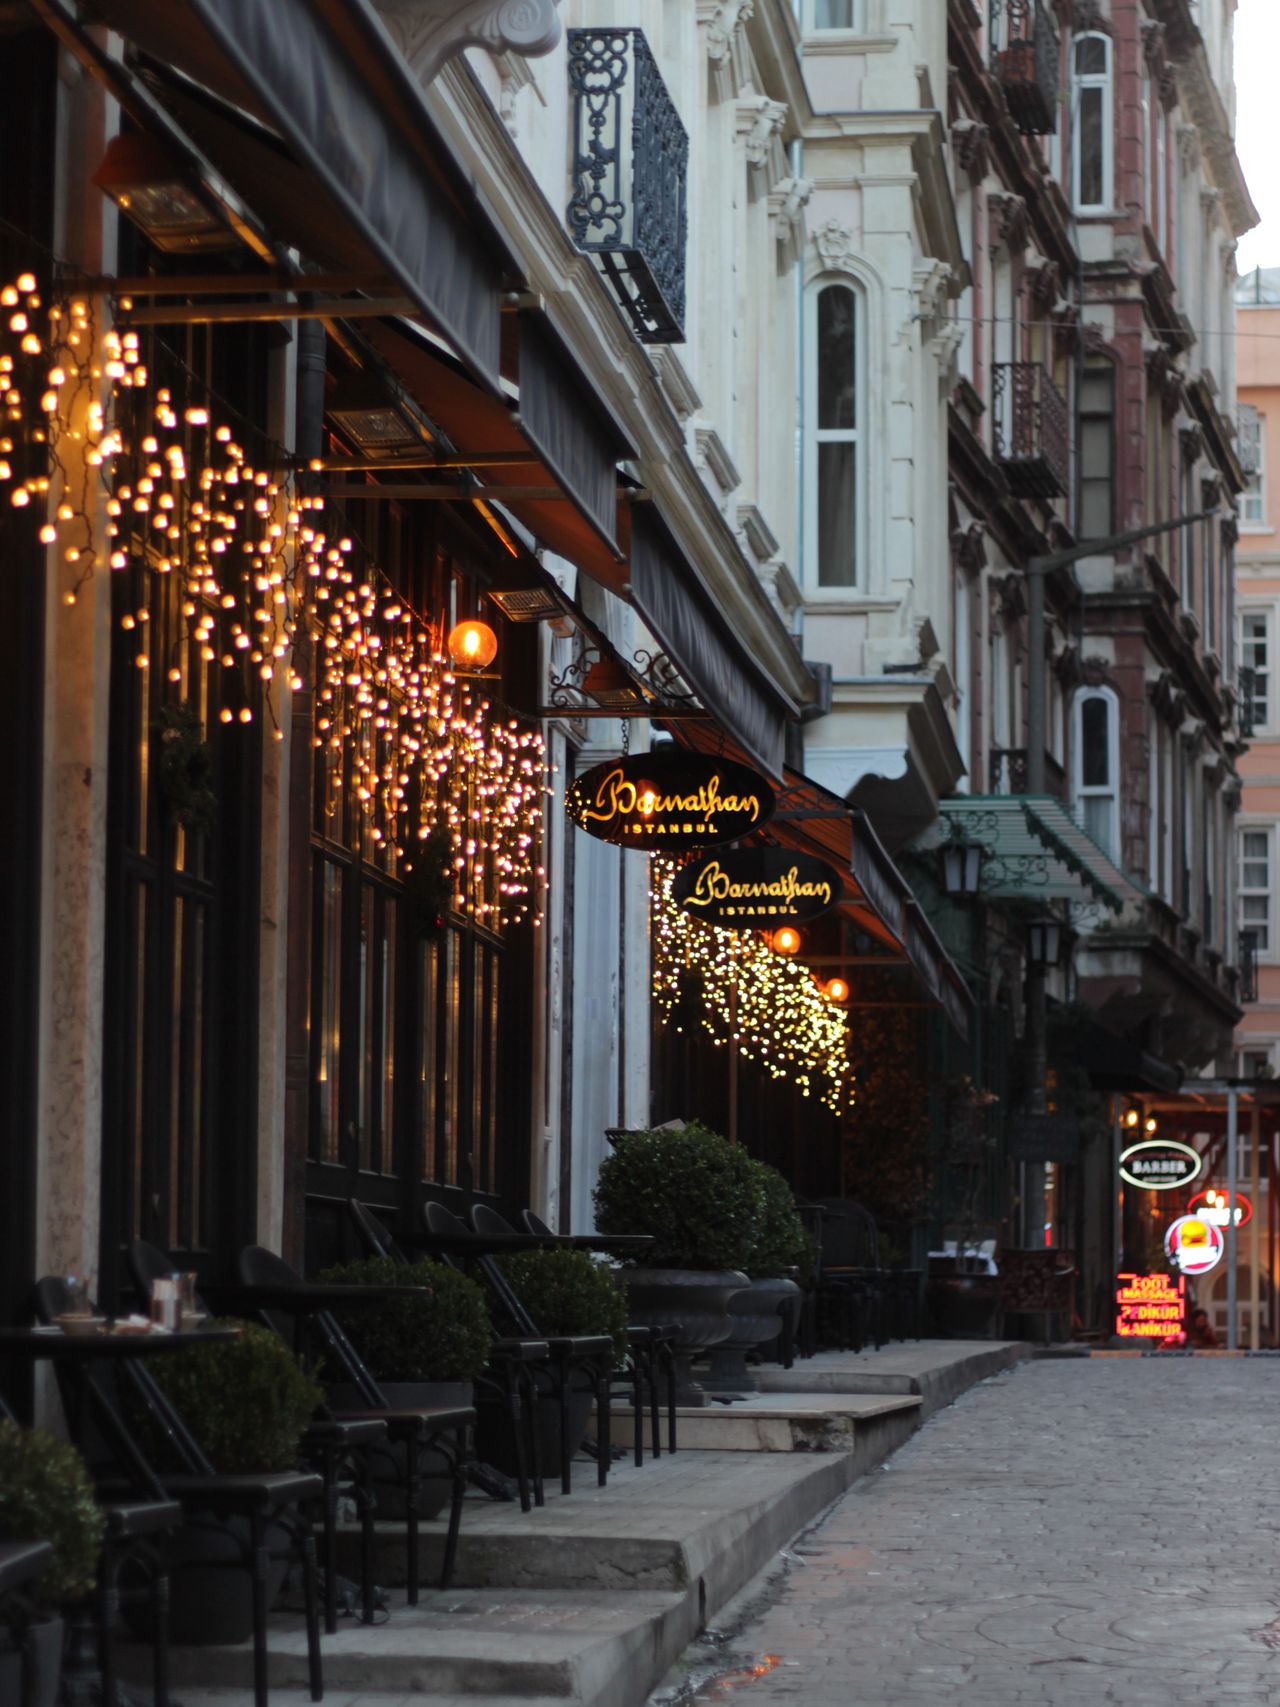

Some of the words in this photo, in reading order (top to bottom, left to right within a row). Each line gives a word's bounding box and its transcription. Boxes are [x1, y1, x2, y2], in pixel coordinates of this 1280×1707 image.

[580, 768, 759, 822] Barnathan
[682, 861, 831, 906] Barnathan
[719, 905, 798, 915] ISTANBUL
[1132, 1160, 1187, 1174] BARBER
[1132, 1277, 1171, 1289] FOOT
[1123, 1288, 1178, 1299] MASSAGE
